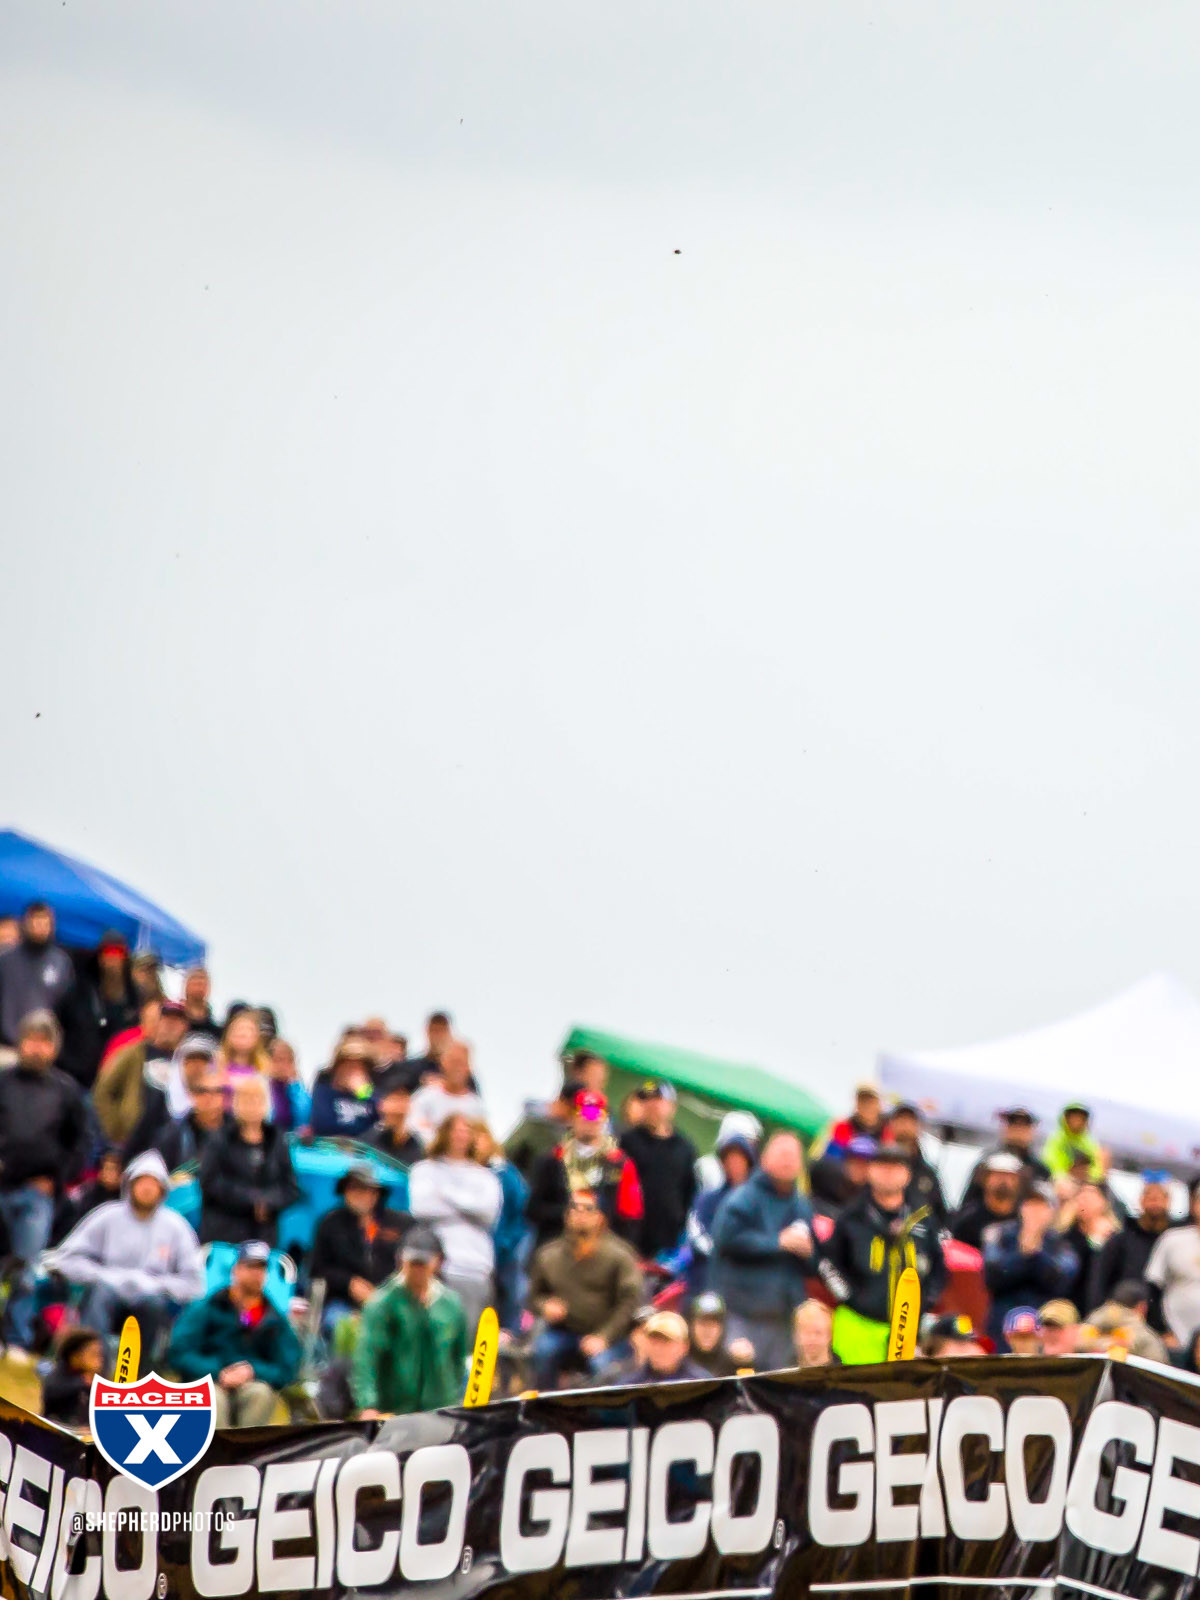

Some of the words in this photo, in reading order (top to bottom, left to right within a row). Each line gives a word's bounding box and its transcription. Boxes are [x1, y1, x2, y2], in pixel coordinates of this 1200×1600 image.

[470, 1340, 488, 1404] CERBIS
[0, 1432, 160, 1600] EICO
[191, 1443, 472, 1599] GEICO
[500, 1413, 781, 1573] GEICO
[808, 1395, 1073, 1547] GEICO
